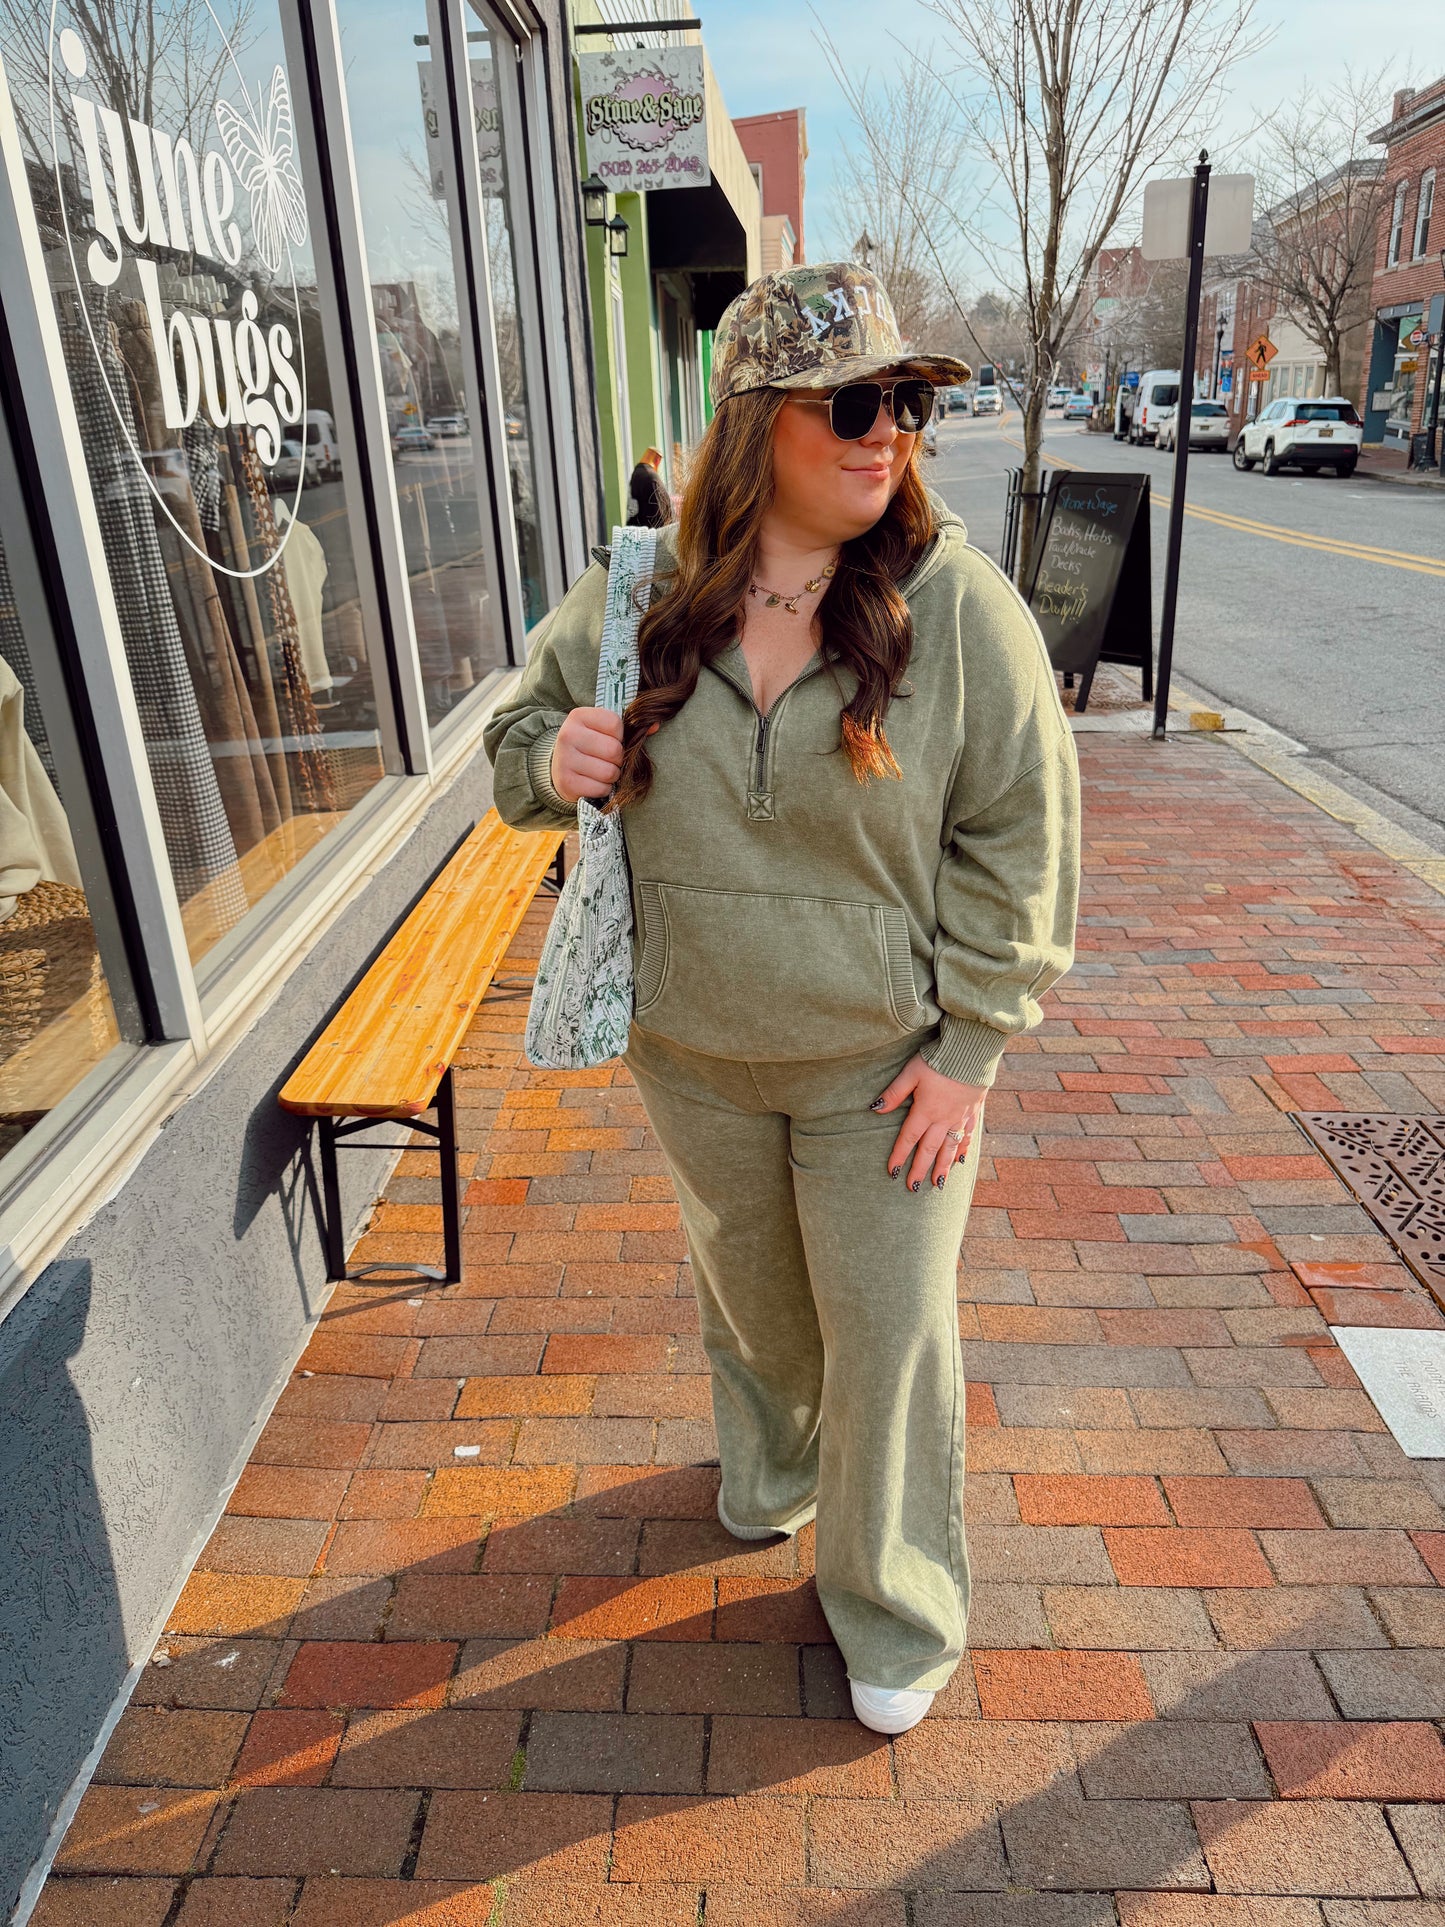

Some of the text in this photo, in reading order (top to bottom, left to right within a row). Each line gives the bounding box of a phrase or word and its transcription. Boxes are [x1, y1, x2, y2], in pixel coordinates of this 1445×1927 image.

[60, 28, 241, 286] june
[136, 259, 301, 467] bugs
[1084, 523, 1113, 545] Herbs
[1051, 555, 1082, 575] Decks
[1037, 570, 1088, 600] Reader's
